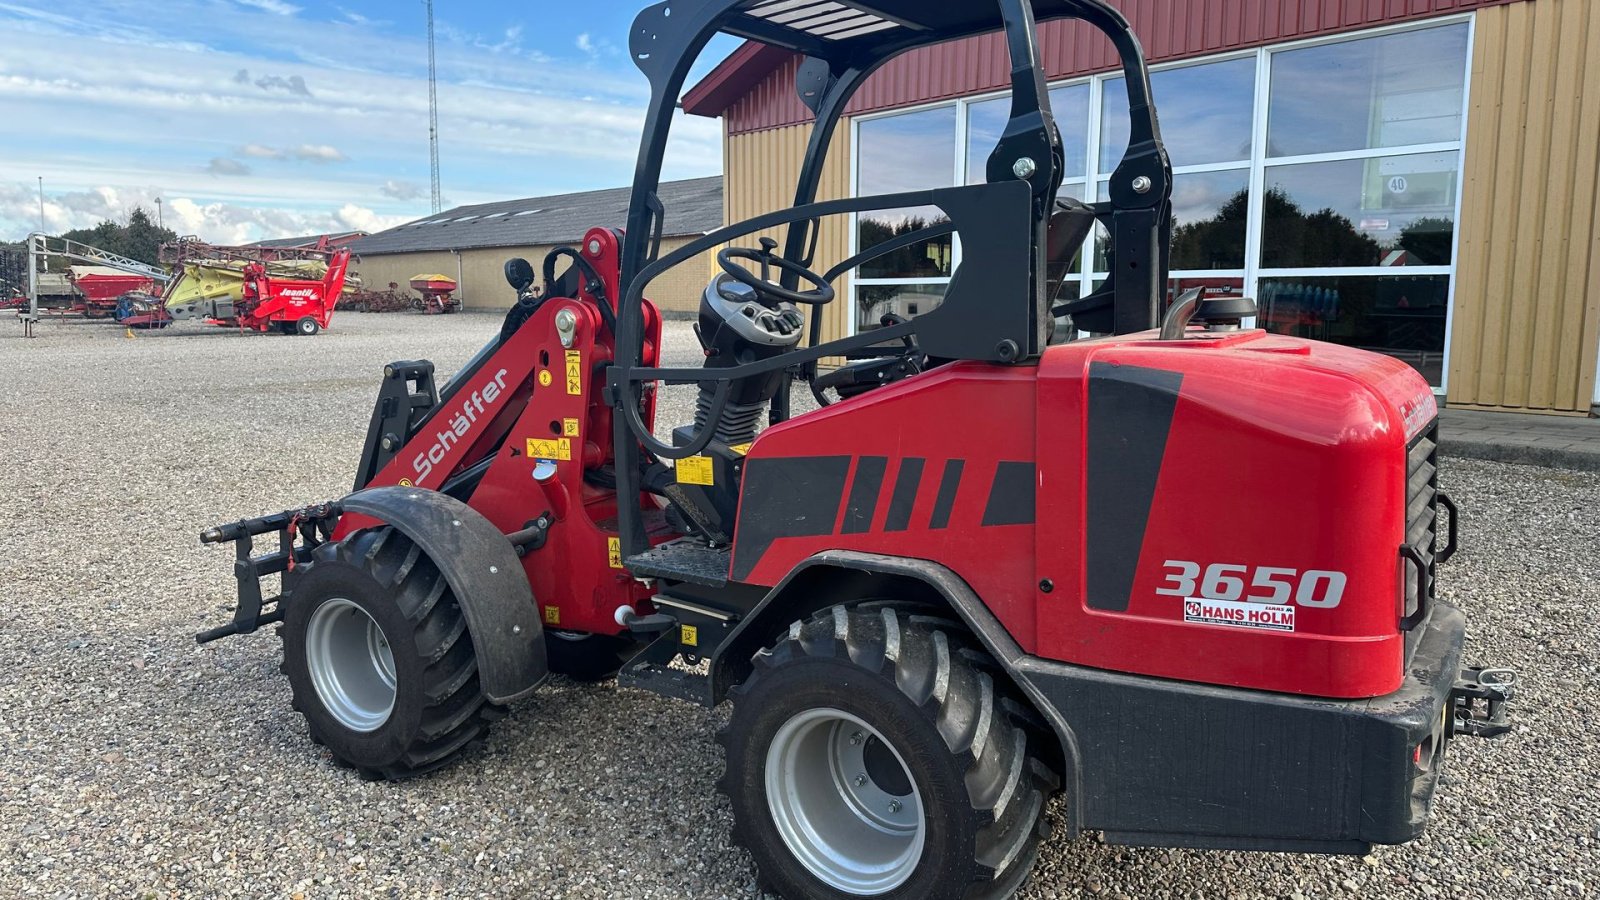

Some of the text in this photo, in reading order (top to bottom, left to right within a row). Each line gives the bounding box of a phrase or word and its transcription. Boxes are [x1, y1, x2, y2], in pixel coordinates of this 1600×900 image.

[1391, 178, 1405, 191] 40
[280, 288, 314, 296] Jeantil
[412, 368, 508, 486] Schäffer
[1155, 559, 1347, 609] 3650
[1202, 606, 1245, 621] HANS
[1248, 610, 1294, 625] HOLM
